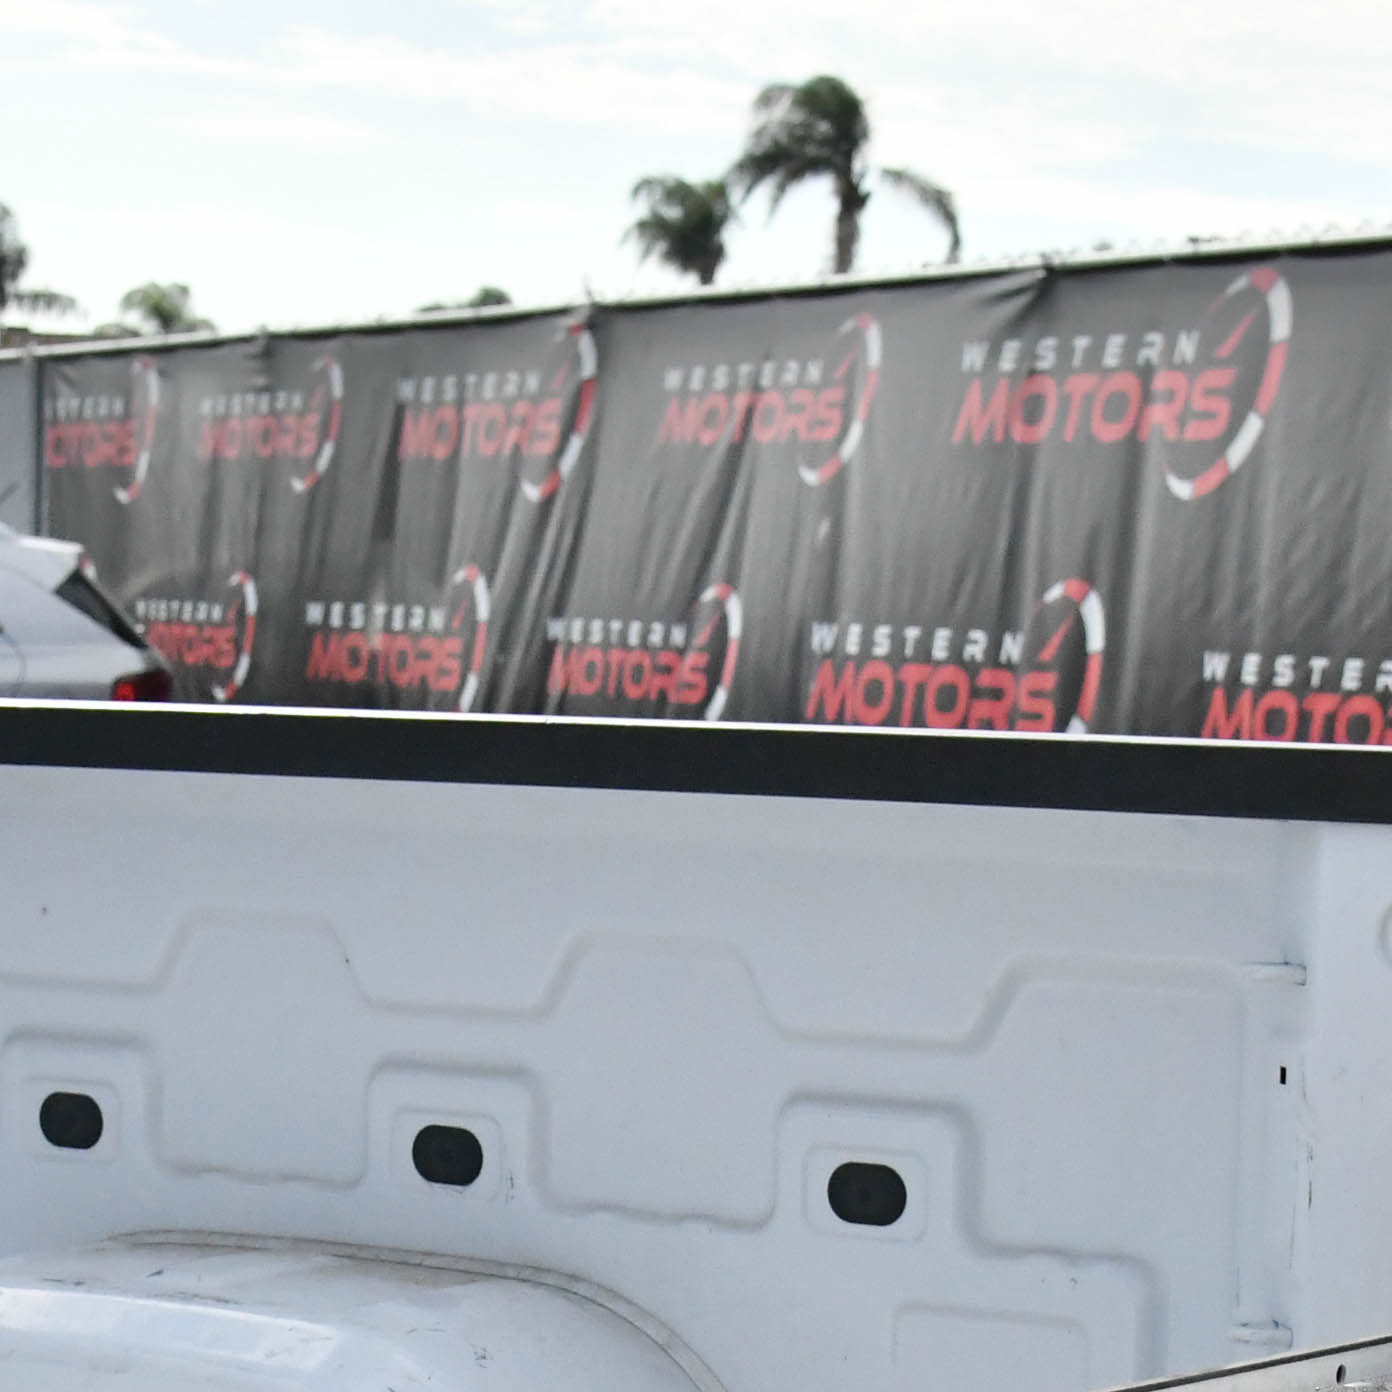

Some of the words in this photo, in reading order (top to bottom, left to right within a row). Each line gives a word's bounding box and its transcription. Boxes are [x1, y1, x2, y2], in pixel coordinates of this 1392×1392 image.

[664, 358, 824, 391] WESTERN
[961, 329, 1200, 373] WESTERN
[397, 398, 562, 463] MOTORS
[658, 386, 846, 446] MOTORS
[952, 367, 1239, 444] MOTORS
[306, 601, 447, 631] WESTERN
[547, 616, 688, 648] WESTERN
[811, 621, 1024, 665] WESTERN
[306, 632, 463, 691] MOTORS
[547, 643, 709, 705] MOTORS
[806, 659, 1057, 731] MOTORS
